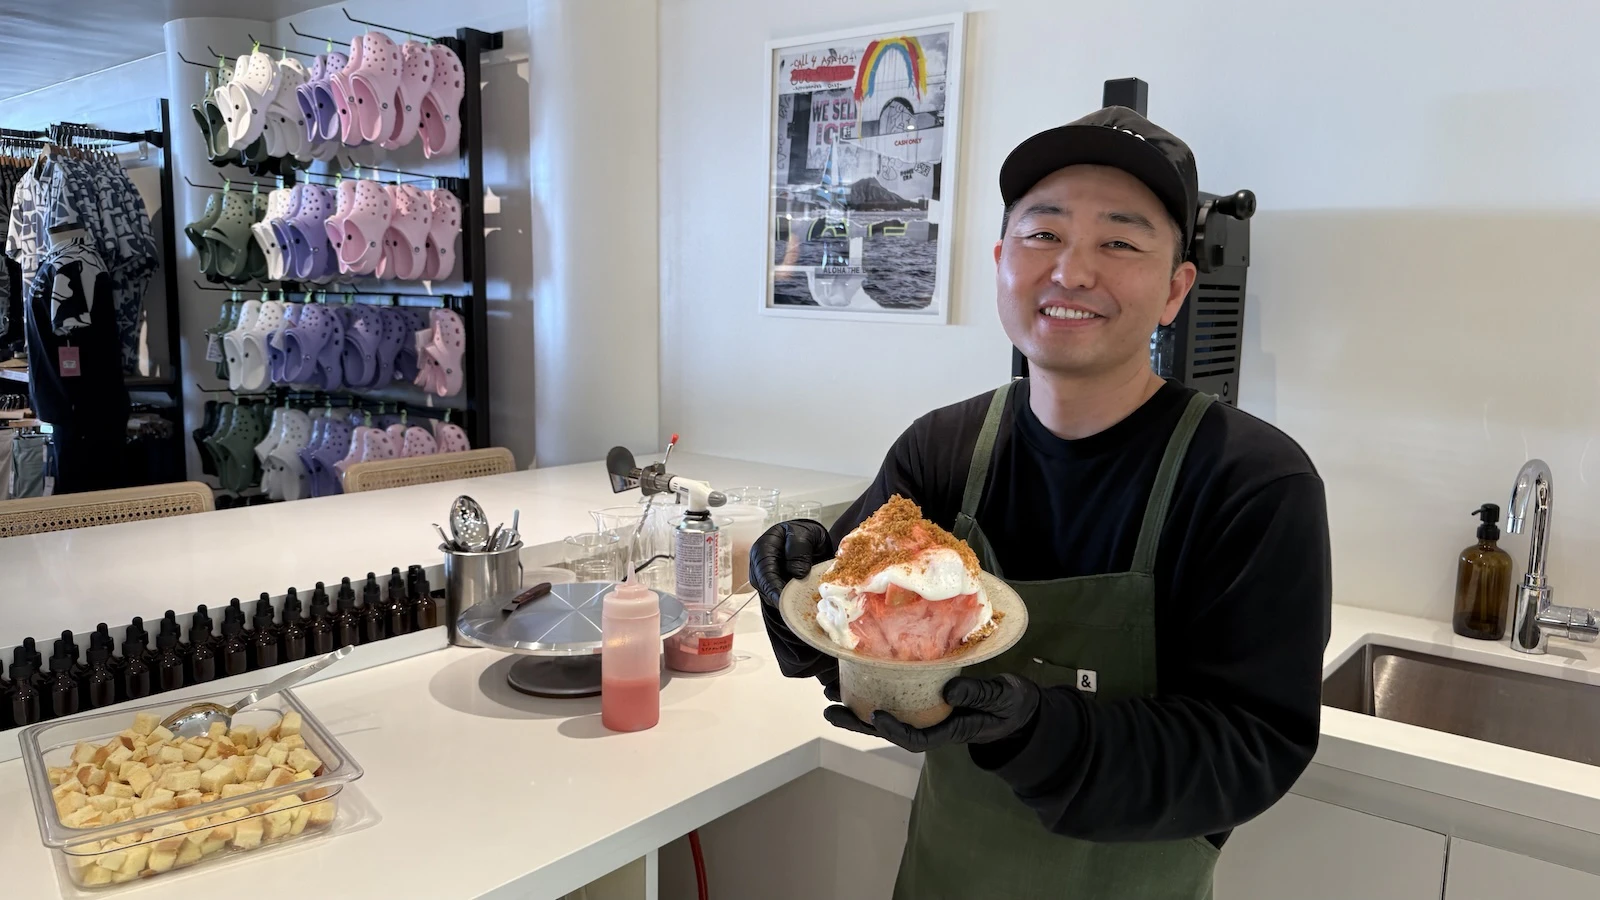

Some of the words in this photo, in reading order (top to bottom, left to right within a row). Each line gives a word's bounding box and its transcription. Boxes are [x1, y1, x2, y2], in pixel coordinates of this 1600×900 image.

[812, 99, 830, 122] WE
[815, 121, 856, 146] ICE
[823, 266, 846, 274] ALOHA
[1081, 674, 1092, 689] &
